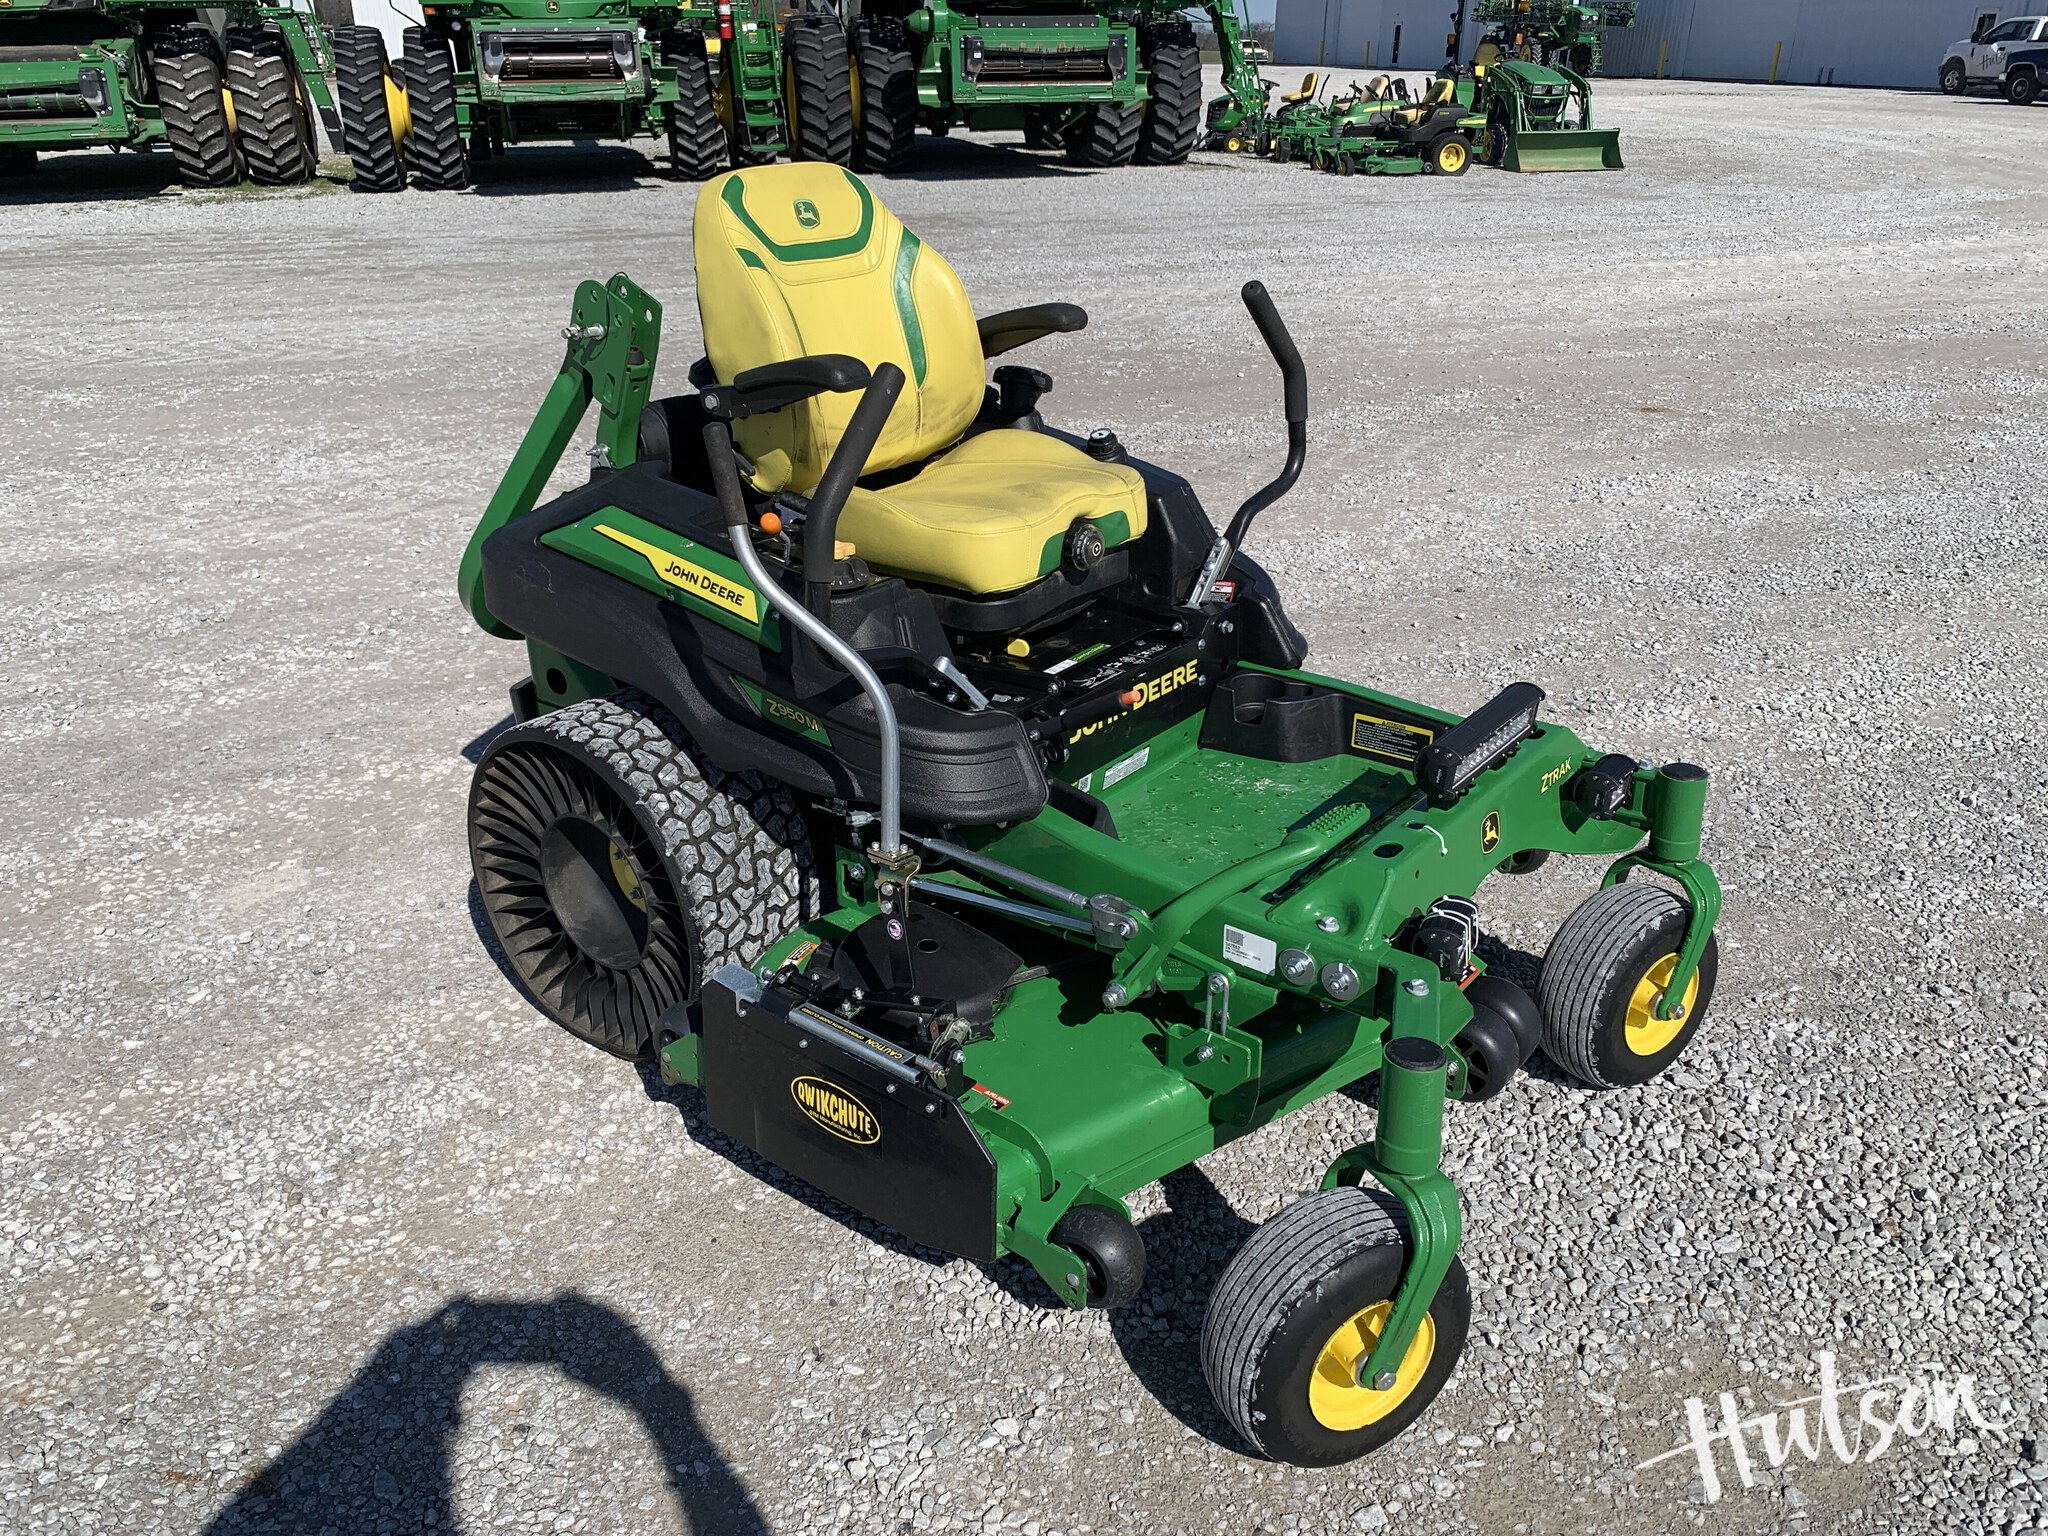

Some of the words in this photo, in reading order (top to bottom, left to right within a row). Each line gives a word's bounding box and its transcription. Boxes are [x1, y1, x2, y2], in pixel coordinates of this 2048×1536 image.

[664, 560, 700, 586] JOHN
[700, 575, 745, 607] DEERE
[1132, 658, 1198, 711] DEERE
[766, 697, 819, 732] Z950M
[1540, 755, 1572, 794] ZTRAK
[865, 1038, 903, 1060] CAUTION
[797, 1081, 872, 1135] QWIKCHUTE
